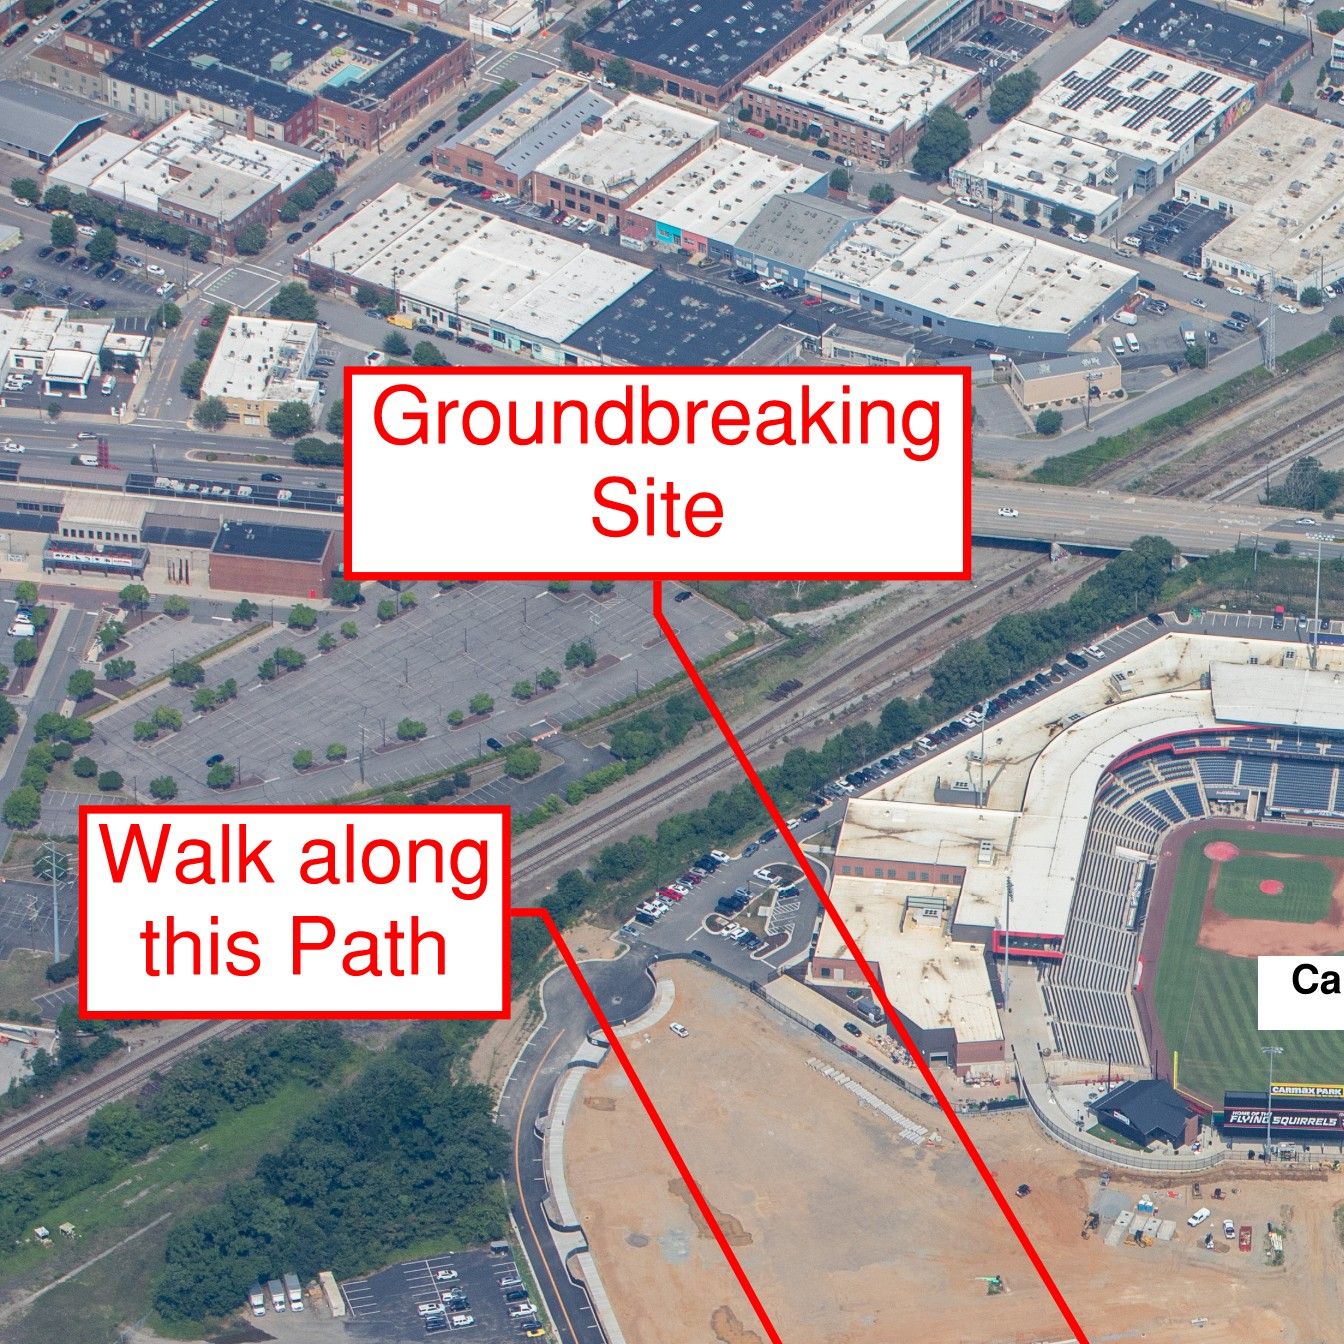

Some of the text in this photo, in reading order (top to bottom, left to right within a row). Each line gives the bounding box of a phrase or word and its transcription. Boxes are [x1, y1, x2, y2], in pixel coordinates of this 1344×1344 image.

[1316, 1087, 1342, 1096] PARK
[1229, 1115, 1338, 1127] FLYING SQUIRRELS
